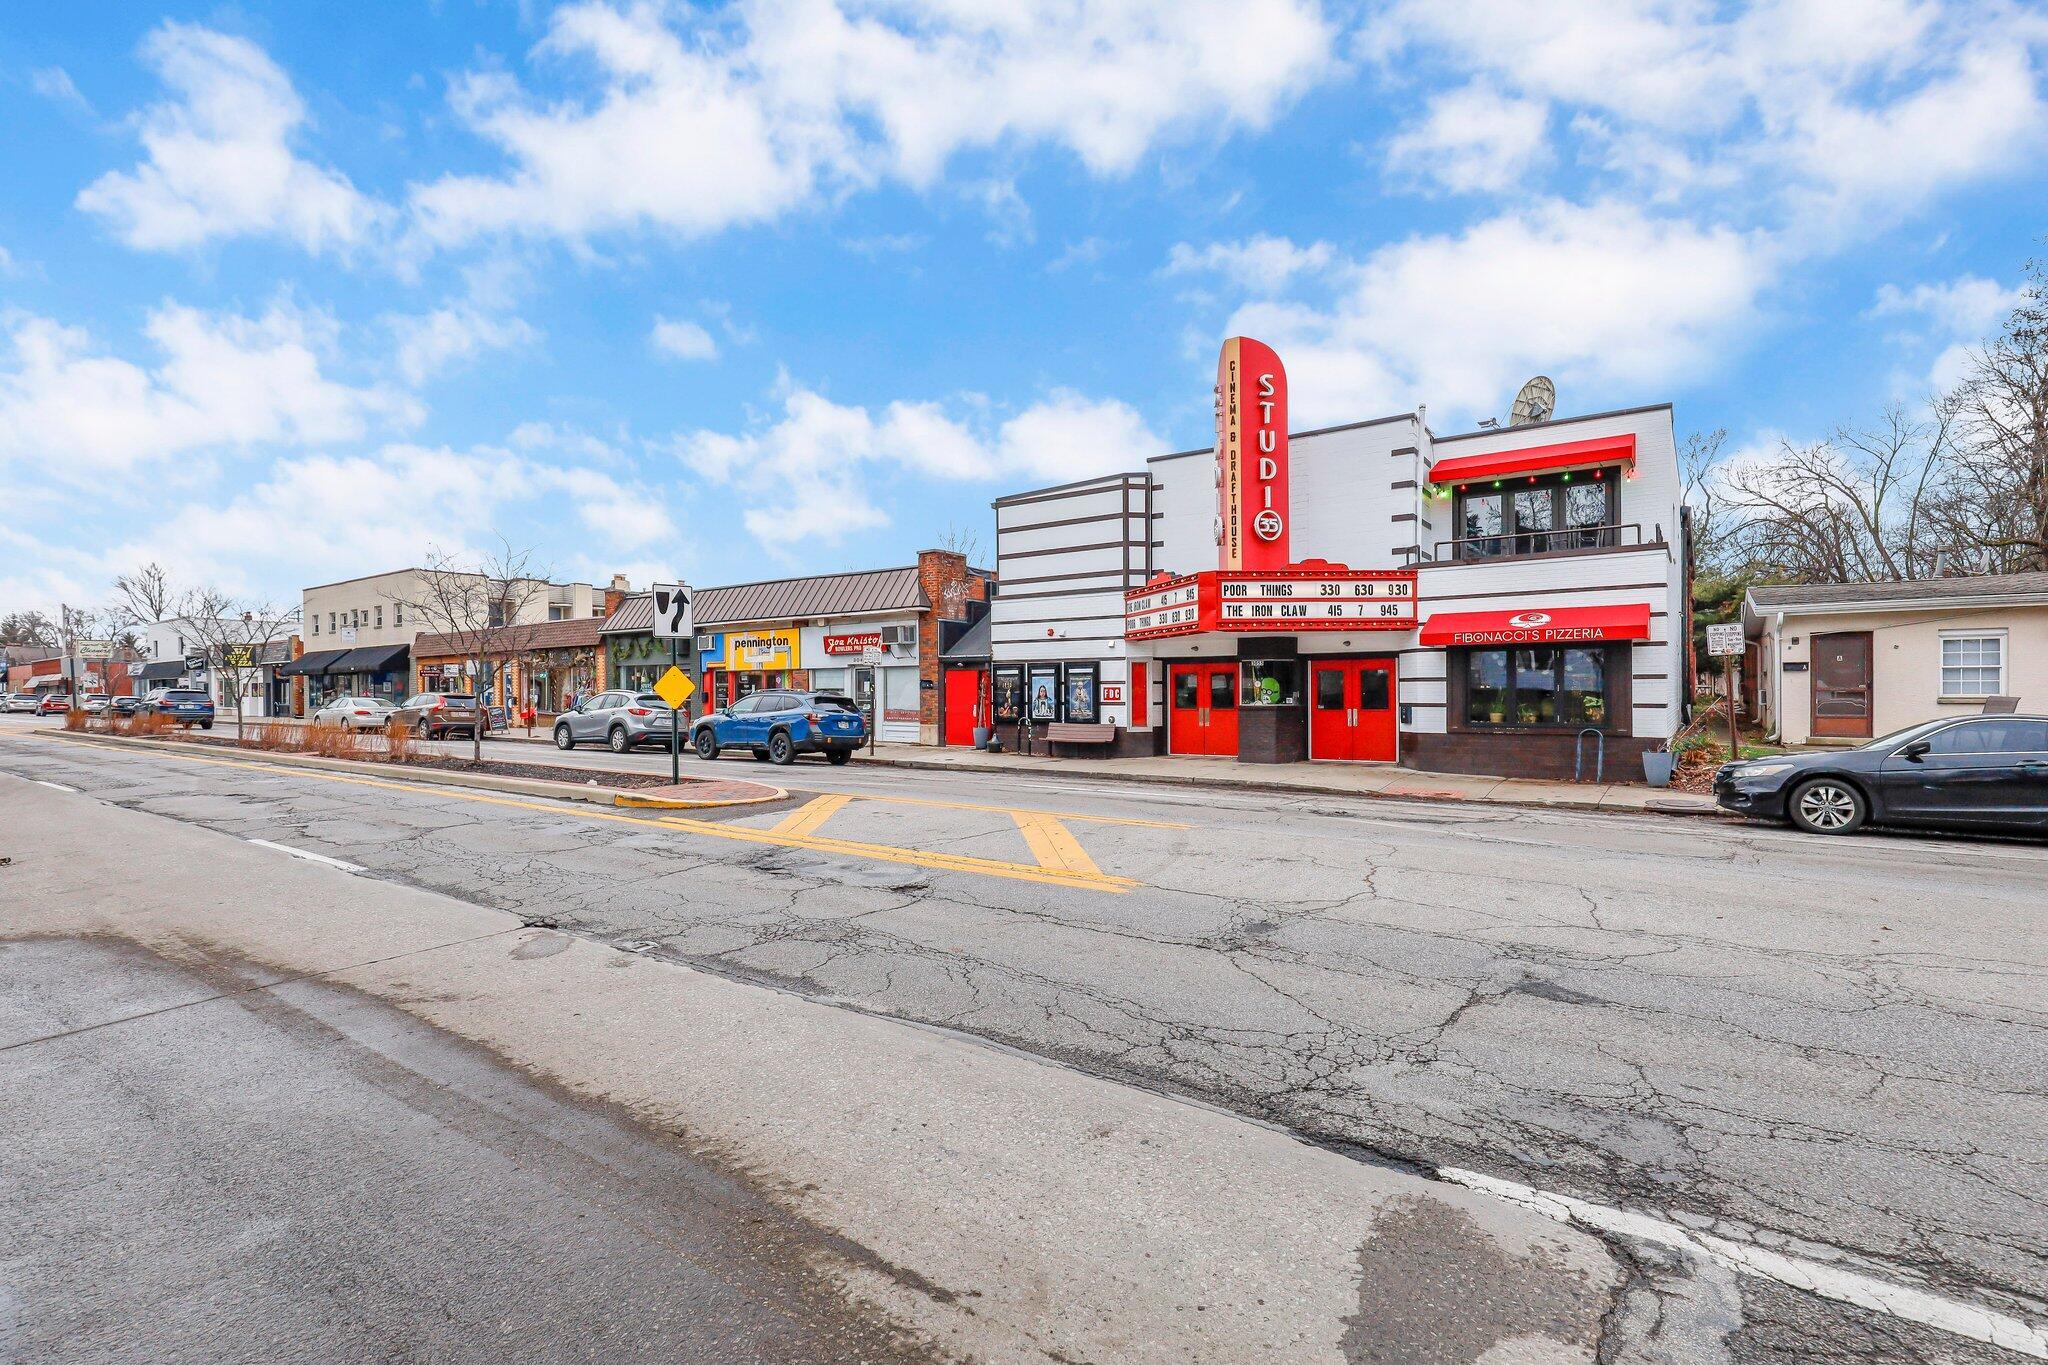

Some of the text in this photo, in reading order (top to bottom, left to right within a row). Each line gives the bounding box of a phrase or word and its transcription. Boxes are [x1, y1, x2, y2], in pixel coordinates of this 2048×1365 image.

[1229, 360, 1238, 559] CINEMA & DRAFTHOUSE
[1259, 517, 1279, 532] 35
[1223, 584, 1408, 596] POOR THINGS 330 630 930
[1134, 601, 1142, 612] IRON
[1142, 599, 1151, 611] CLAW
[1174, 592, 1178, 603] 7
[1186, 588, 1194, 600] 945
[1128, 608, 1194, 629] POOR THINGS 330 630 930
[1226, 605, 1398, 617] THE IRON CLAW 415 7 945
[1454, 628, 1604, 643] FIBONACCI'S PIZZERIA
[734, 637, 789, 651] pennington
[827, 638, 845, 653] Joe
